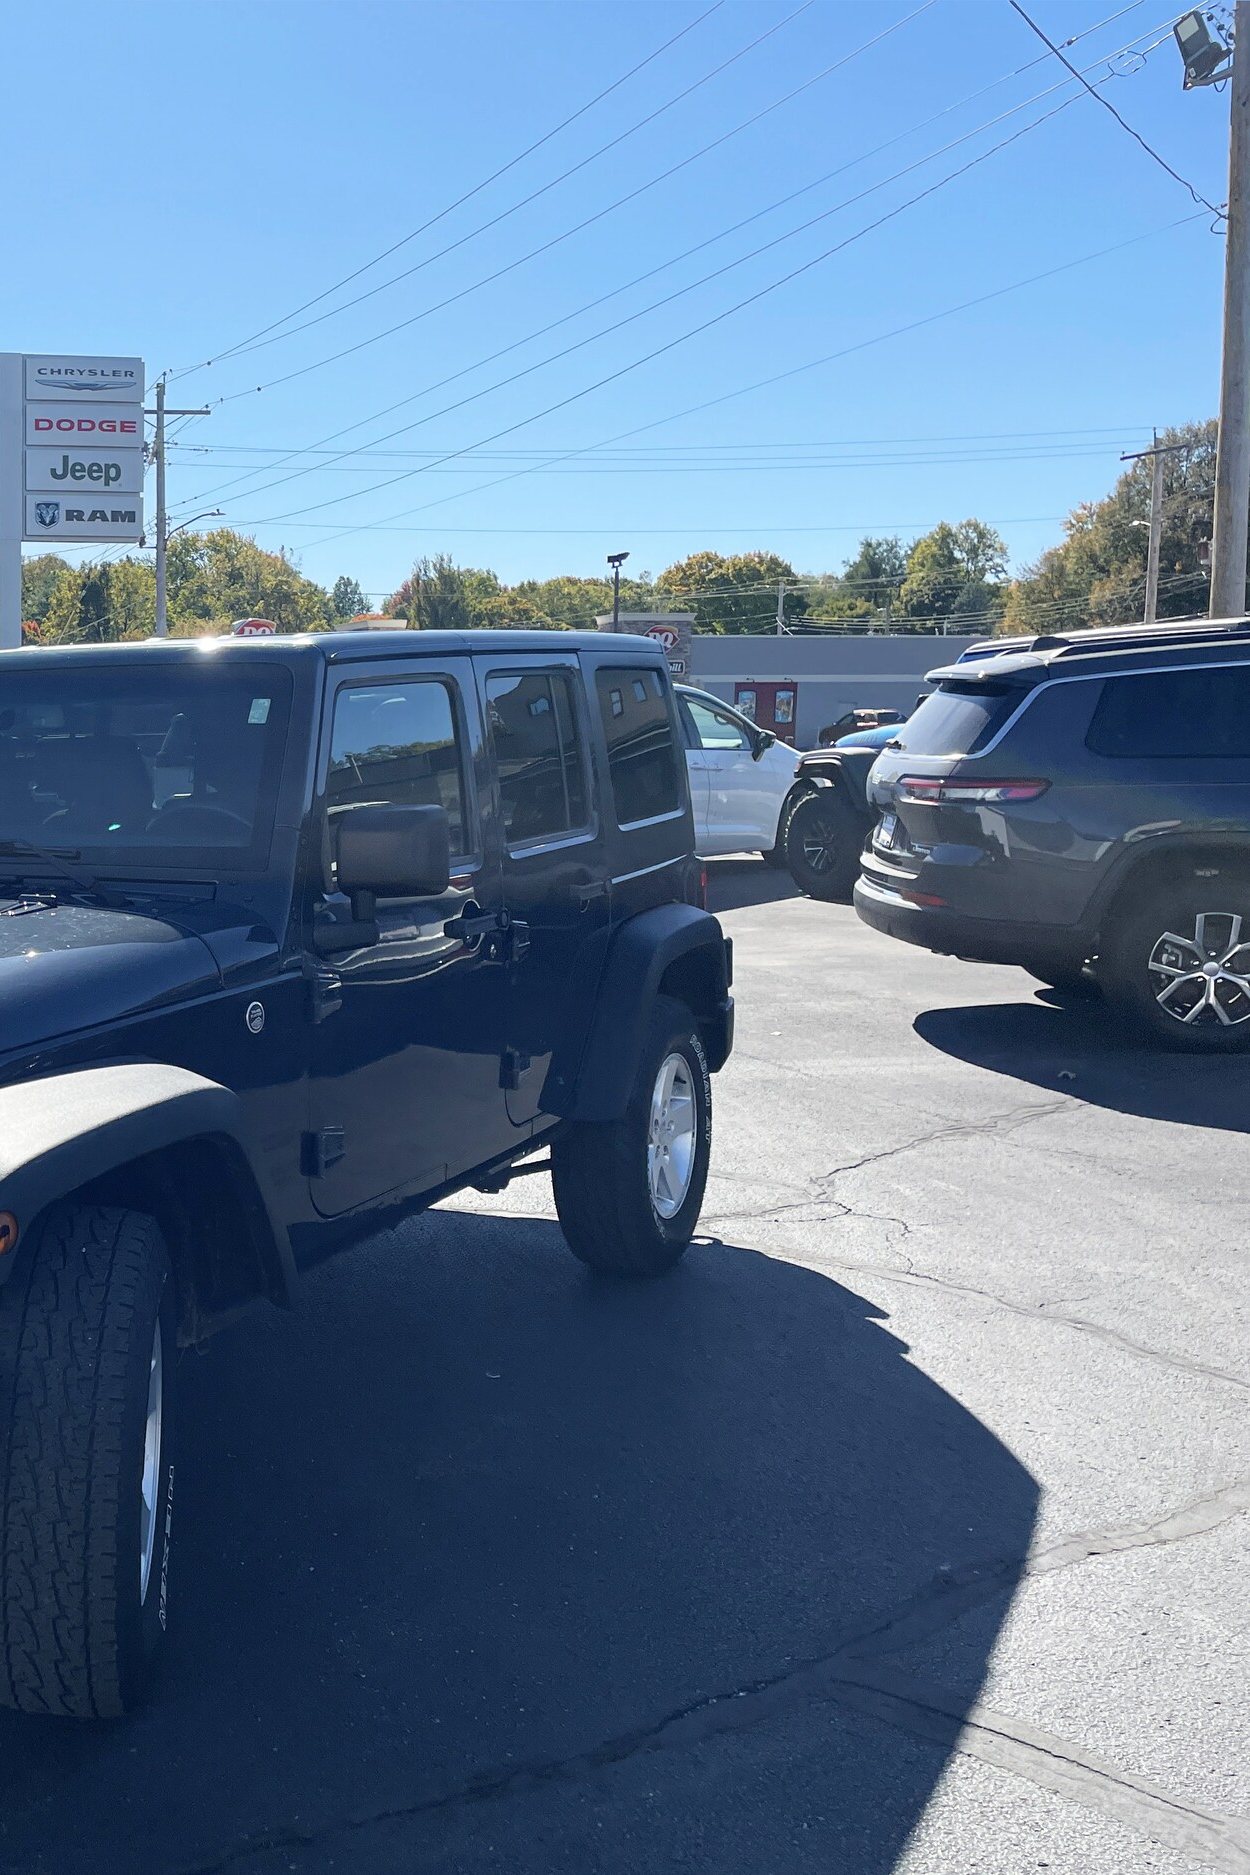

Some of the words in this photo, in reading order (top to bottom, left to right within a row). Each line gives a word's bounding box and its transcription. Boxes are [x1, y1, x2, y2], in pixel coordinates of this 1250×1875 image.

[37, 367, 135, 378] CHRYSLER
[34, 418, 137, 433] DODGE
[50, 454, 122, 487] Jeep
[65, 509, 136, 523] RAM
